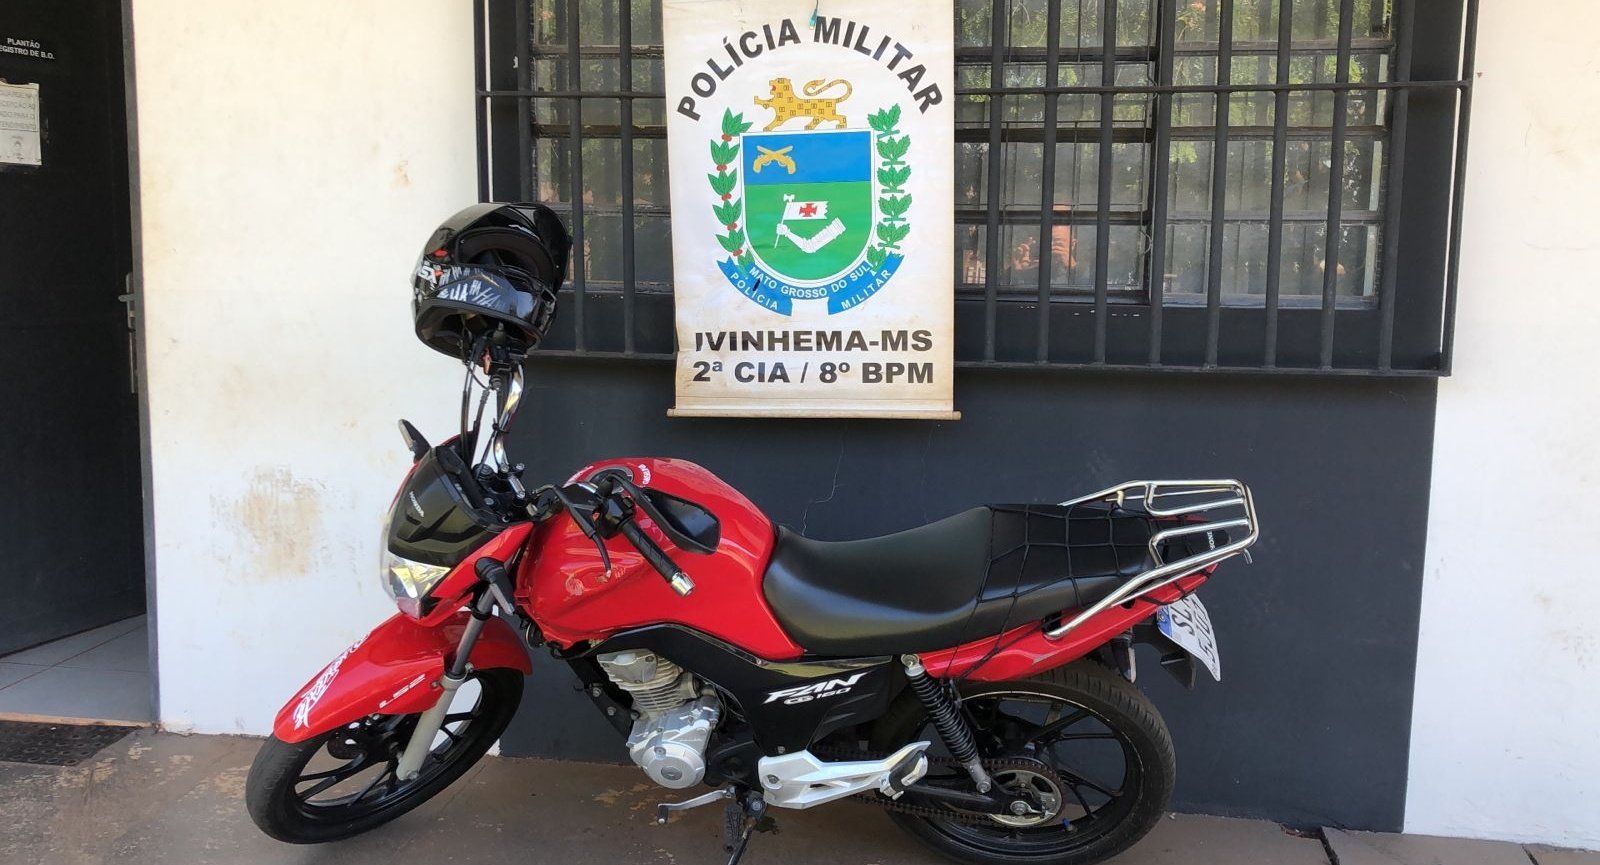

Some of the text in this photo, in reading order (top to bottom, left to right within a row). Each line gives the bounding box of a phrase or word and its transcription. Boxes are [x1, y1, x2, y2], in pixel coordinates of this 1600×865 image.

[7, 37, 40, 49] PLANTÃO
[30, 49, 40, 57] DE
[677, 16, 943, 122] POLÍCIA MILITAR
[749, 263, 871, 299] MATO GROSSO DO SUL
[841, 269, 891, 310] MILITAR
[695, 329, 933, 352] IVINHEMA-MS
[734, 361, 790, 383] CIA
[800, 361, 808, 384] /
[862, 361, 934, 384] BPM
[762, 671, 870, 704] FAN
[816, 687, 852, 699] 160
